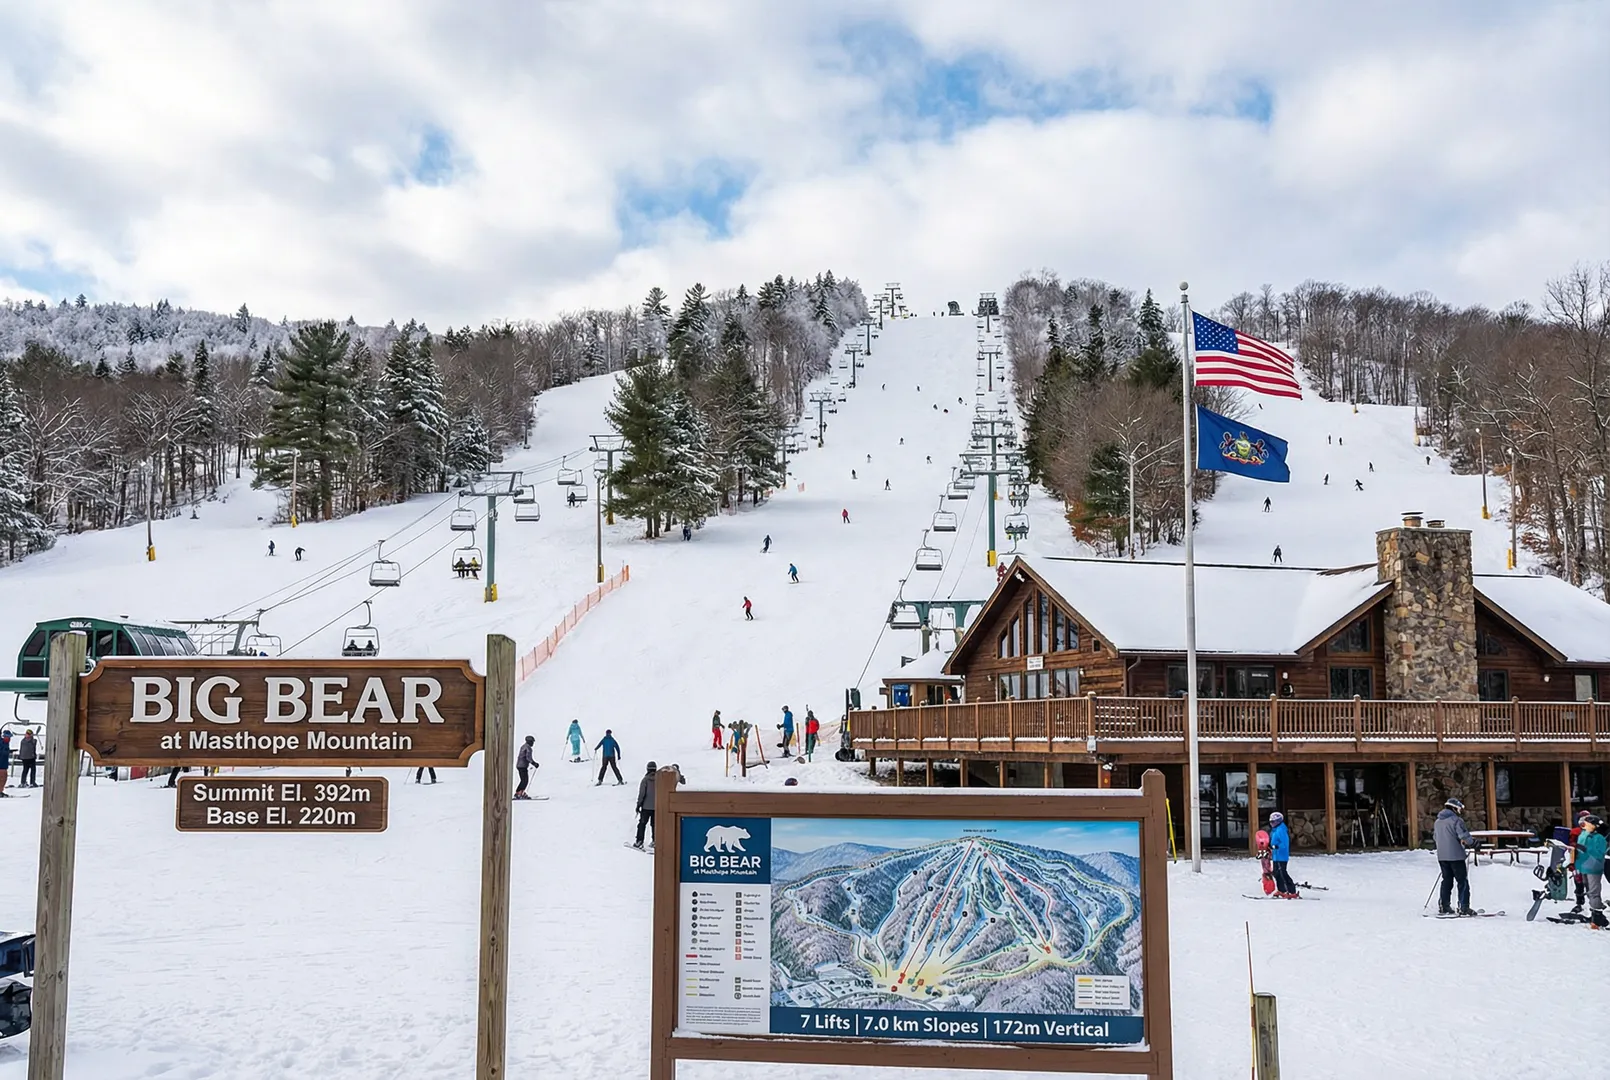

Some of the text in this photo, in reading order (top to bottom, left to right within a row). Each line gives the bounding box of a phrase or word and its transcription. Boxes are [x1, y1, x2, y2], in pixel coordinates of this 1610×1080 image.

[130, 676, 445, 723] BIG BEAR
[160, 730, 412, 754] at Masthope Mountain
[193, 783, 370, 802] Summit El. 392m
[207, 807, 356, 825] Base El. 220m
[689, 855, 761, 868] BIG BEAR
[800, 1013, 1110, 1037] 7 Lifts 7.0 km Slopes 172m Vertical
